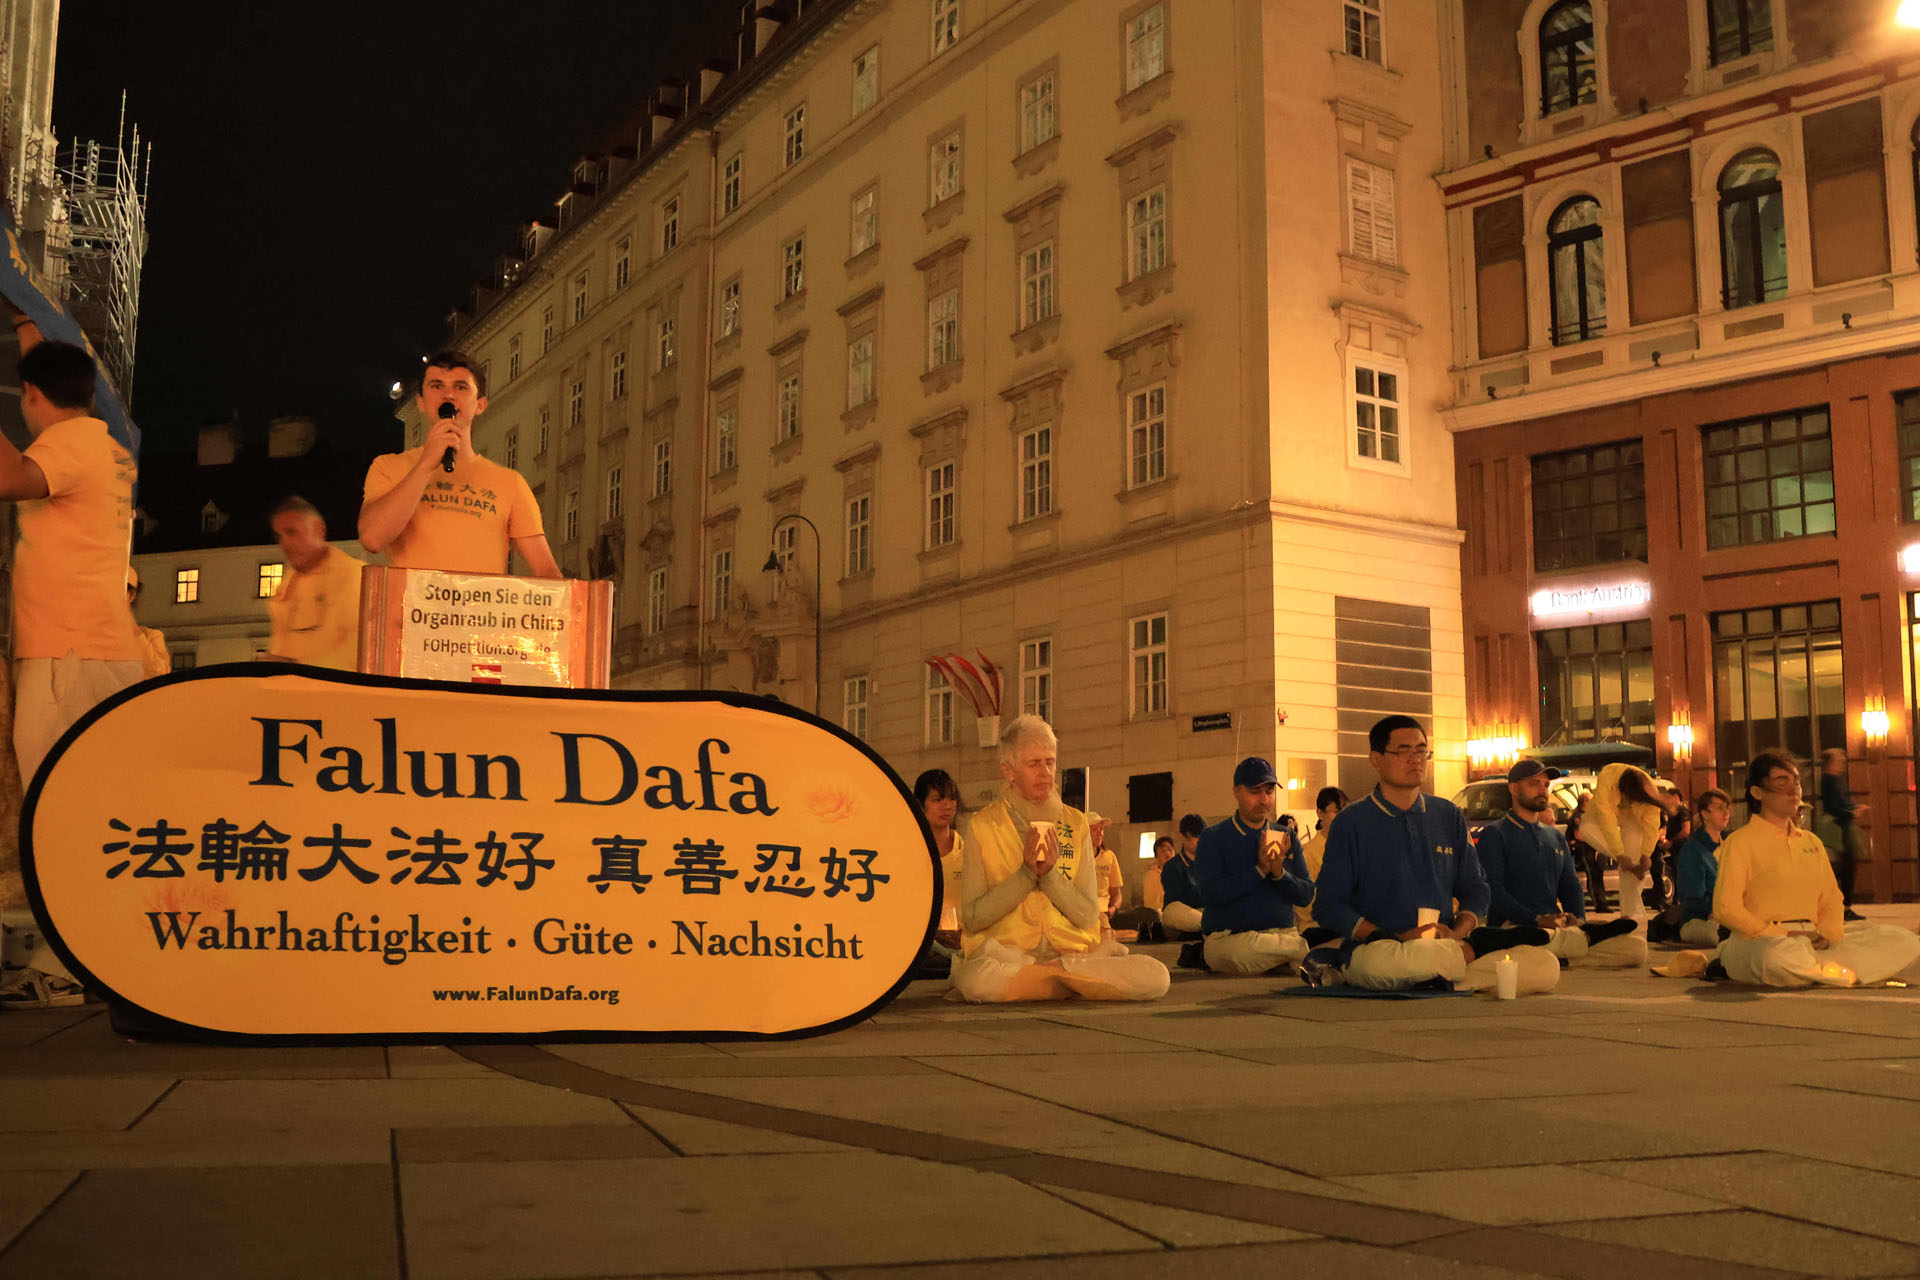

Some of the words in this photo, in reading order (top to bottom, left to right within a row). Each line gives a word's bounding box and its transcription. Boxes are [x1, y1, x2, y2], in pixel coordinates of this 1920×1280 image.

[421, 493, 459, 505] ALUN
[464, 496, 497, 514] DAFA
[425, 584, 491, 606] Stoppen
[495, 588, 519, 604] Sie
[523, 589, 552, 606] den
[411, 608, 497, 630] Organraub
[501, 612, 516, 629] in
[520, 614, 565, 631] China
[249, 717, 528, 801] Falun
[550, 732, 779, 817] Dafa
[102, 817, 555, 890] 法輪大法好
[587, 835, 890, 902] 真善忍好
[145, 909, 491, 965] Wahrhaftigkeit
[533, 917, 633, 955] Güte
[671, 921, 864, 960] Nachsicht
[432, 984, 620, 1006] www.FalunDafa.org
